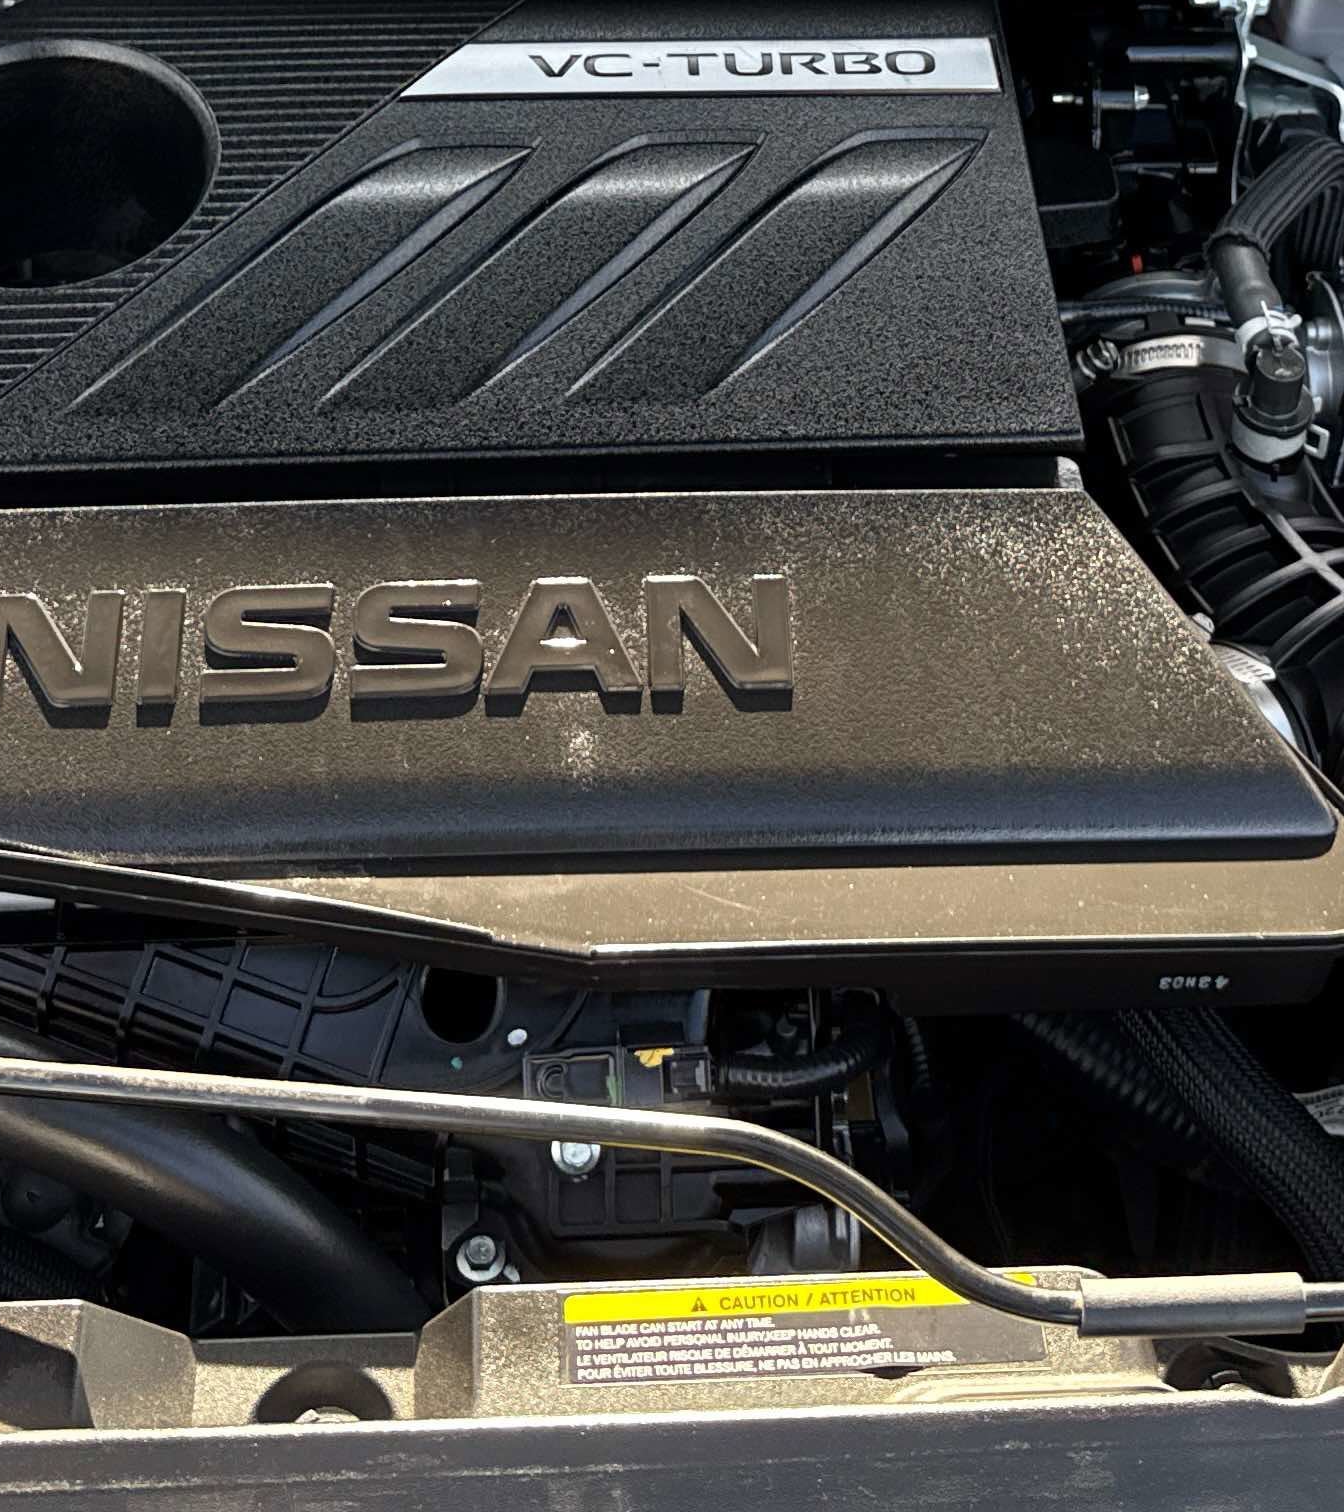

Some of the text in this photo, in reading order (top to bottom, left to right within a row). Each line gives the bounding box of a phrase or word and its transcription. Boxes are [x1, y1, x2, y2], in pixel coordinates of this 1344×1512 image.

[528, 49, 937, 78] VC-TURBO
[719, 1293, 799, 1310] CAUTION
[819, 1288, 916, 1305] ATTENTION
[575, 1326, 598, 1337] FAN
[600, 1324, 639, 1336] BLADE
[640, 1323, 665, 1334] CAN
[666, 1320, 703, 1333] START
[704, 1320, 719, 1331] AT
[719, 1318, 744, 1330] ANY
[576, 1340, 592, 1351] TO
[594, 1338, 625, 1350] HELP
[626, 1335, 661, 1348] AVOID
[663, 1333, 726, 1347] PERSONAL
[797, 1326, 838, 1339] HANDS
[839, 1323, 881, 1336] CLEAR.
[576, 1338, 894, 1366] LE VENTILATEUR RISQUE DE DÉMARRER À TOUT MOMENT.
[578, 1350, 956, 1380] POUR ÉVITER TOUTE BLESSURE, NE PAS EN APPROCHER LES MAINS.
